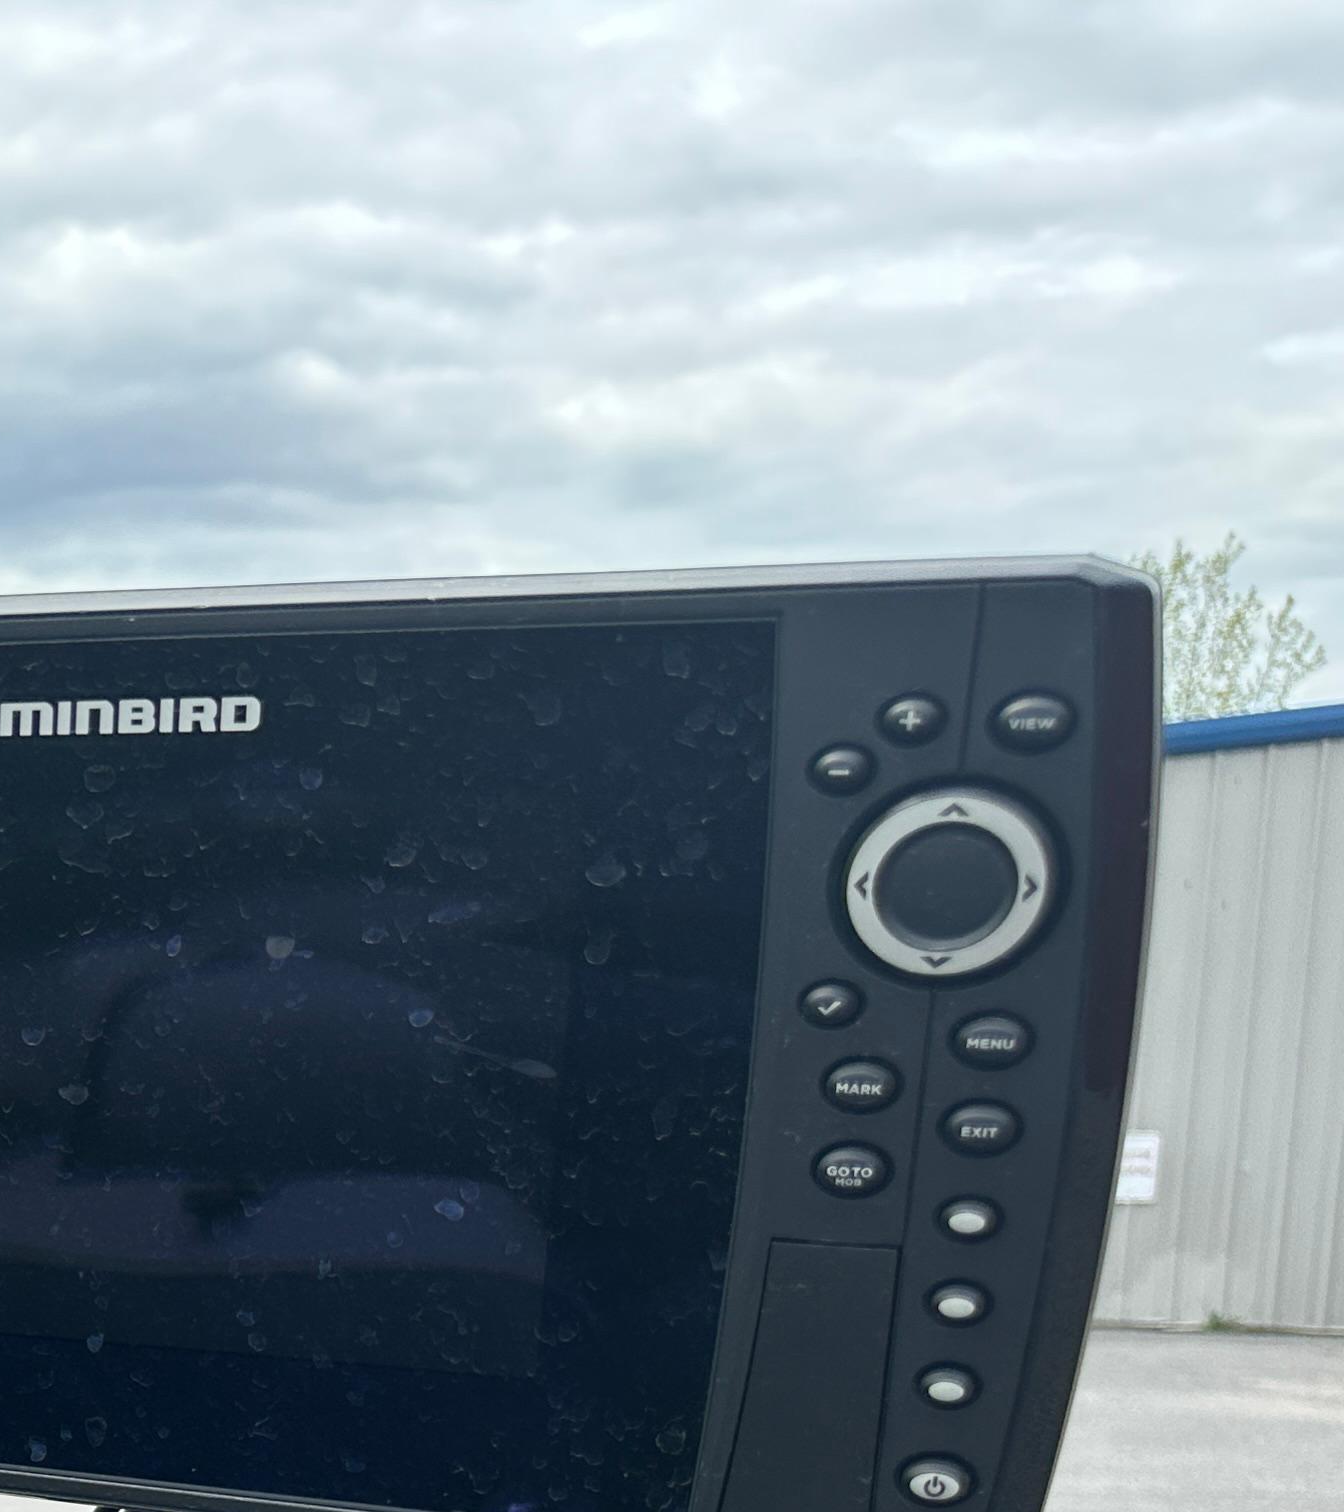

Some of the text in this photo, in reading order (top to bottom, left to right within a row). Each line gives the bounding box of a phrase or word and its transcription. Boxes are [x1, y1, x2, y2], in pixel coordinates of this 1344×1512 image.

[1008, 717, 1056, 731] VIEW
[965, 1038, 1015, 1050] MENU
[835, 1082, 882, 1095] MARK
[960, 1126, 998, 1138] EXIT
[835, 1178, 862, 1187] MOB
